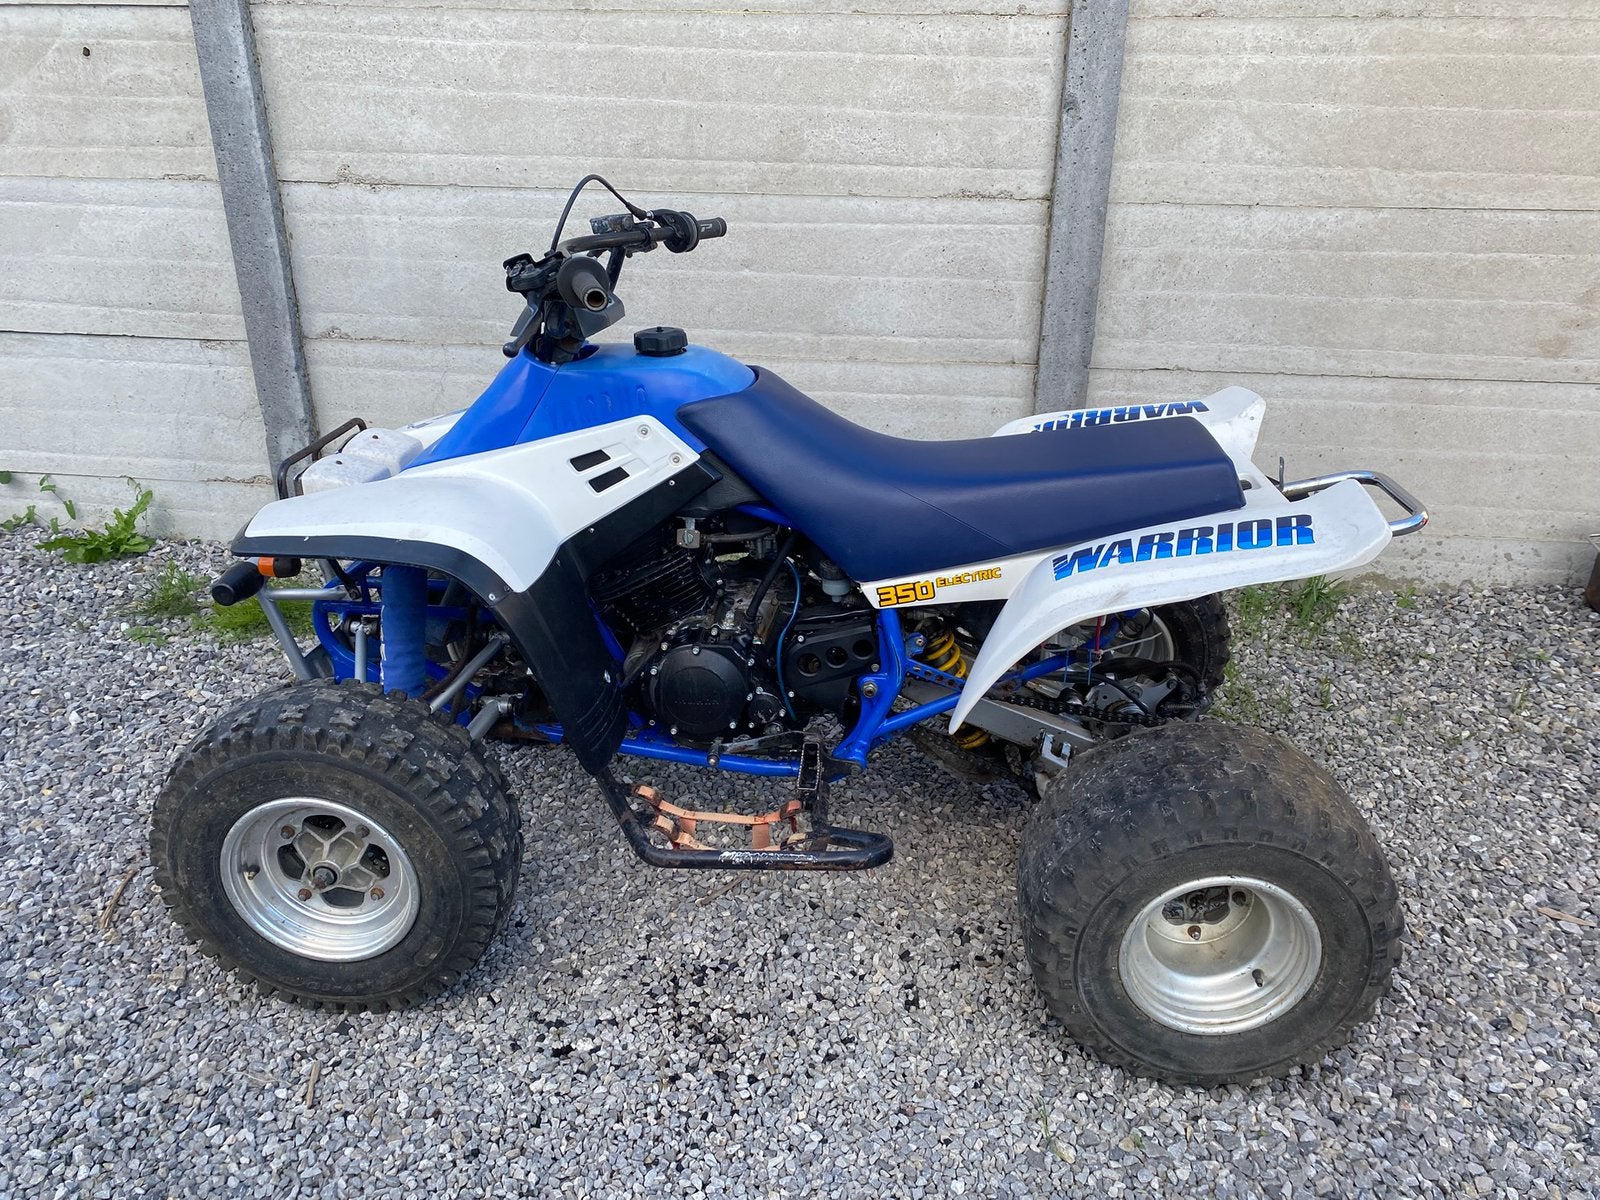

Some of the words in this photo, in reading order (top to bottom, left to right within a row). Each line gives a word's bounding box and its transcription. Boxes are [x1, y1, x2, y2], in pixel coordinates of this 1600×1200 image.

[1052, 514, 1316, 581] WARRIOR
[876, 580, 936, 607] 350
[936, 567, 1002, 588] ELECTRIC
